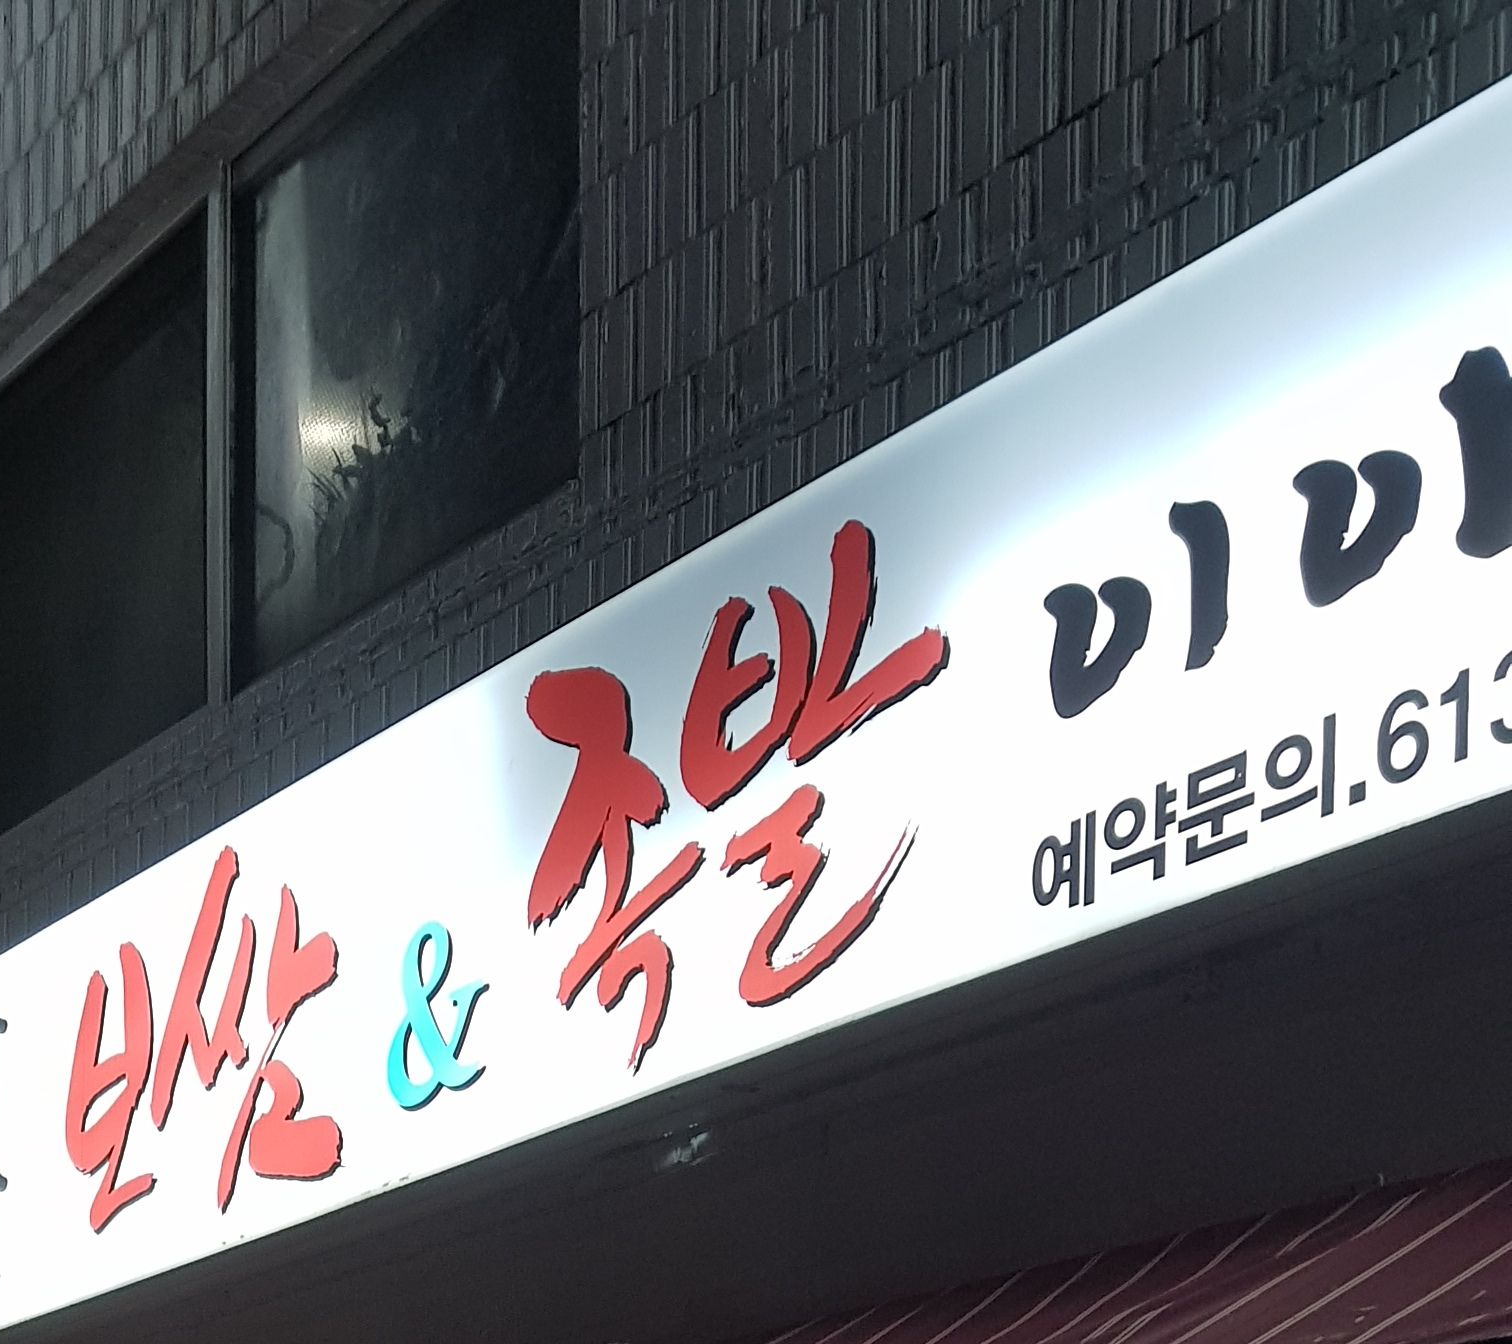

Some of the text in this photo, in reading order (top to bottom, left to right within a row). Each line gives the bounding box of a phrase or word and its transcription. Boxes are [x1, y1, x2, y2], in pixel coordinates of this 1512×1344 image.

[62, 517, 951, 1234] 보쌈 & 족발
